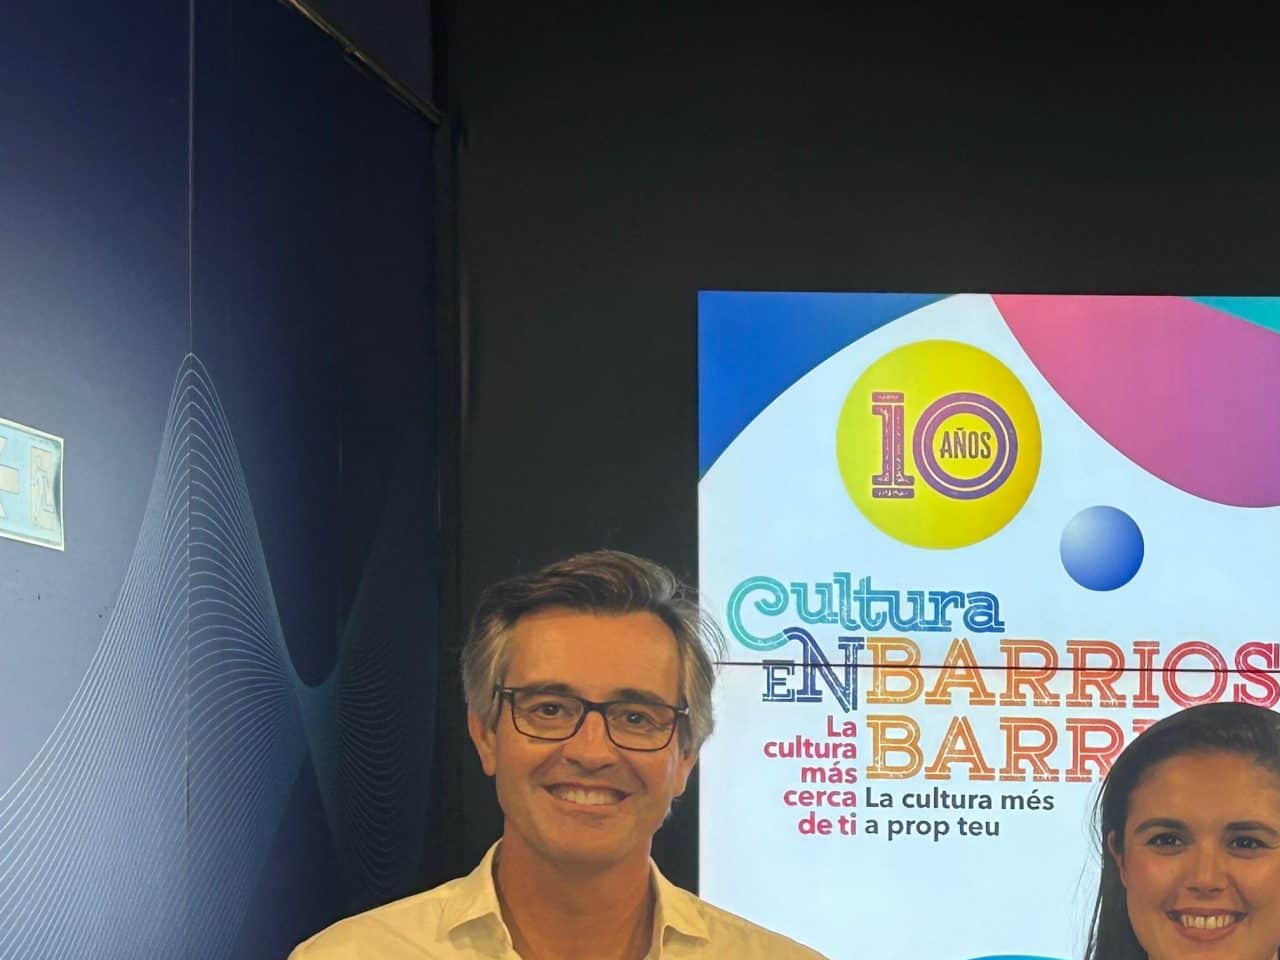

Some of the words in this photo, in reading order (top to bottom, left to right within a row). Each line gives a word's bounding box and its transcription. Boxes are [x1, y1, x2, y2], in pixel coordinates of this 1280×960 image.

[872, 392, 1018, 500] 10
[940, 427, 992, 460] AÑOS
[727, 572, 1005, 651] Cultura
[762, 627, 865, 713] EN
[828, 715, 857, 737] La
[763, 736, 857, 759] cultura
[866, 715, 1160, 782] BARR
[801, 762, 857, 783] más
[783, 789, 857, 807] cerca
[865, 787, 893, 808] La
[902, 788, 992, 809] cultura
[1001, 790, 1055, 810] més
[798, 812, 832, 835] de
[839, 814, 857, 835] ti
[865, 819, 879, 835] a
[888, 818, 950, 841] prop
[957, 817, 1000, 836] teu
